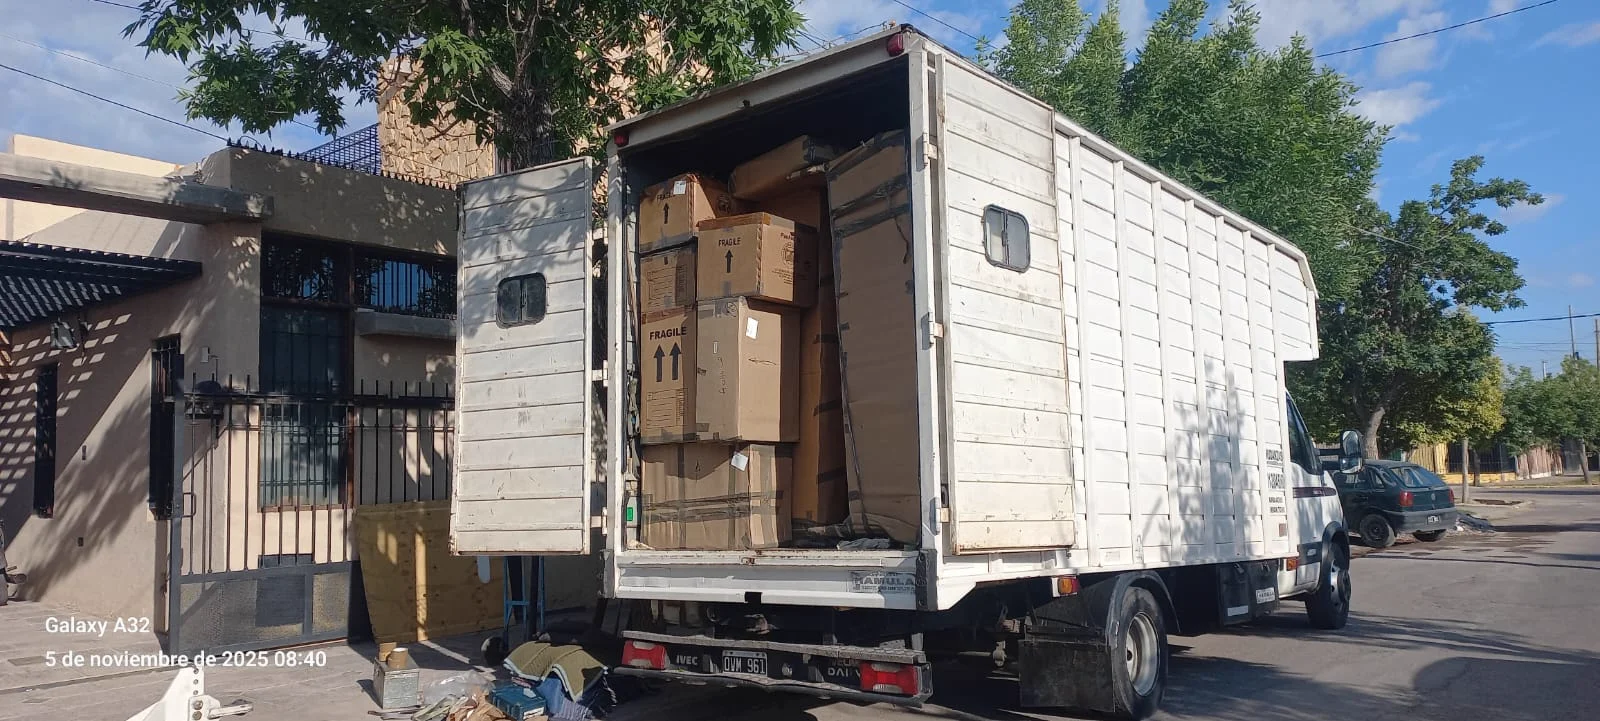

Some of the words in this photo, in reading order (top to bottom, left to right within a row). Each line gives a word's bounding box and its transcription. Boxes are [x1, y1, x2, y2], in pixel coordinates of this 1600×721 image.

[719, 237, 741, 246] FRAGILE
[649, 326, 688, 341] FRAGILE
[724, 656, 742, 673] OVM
[747, 658, 766, 674] 961
